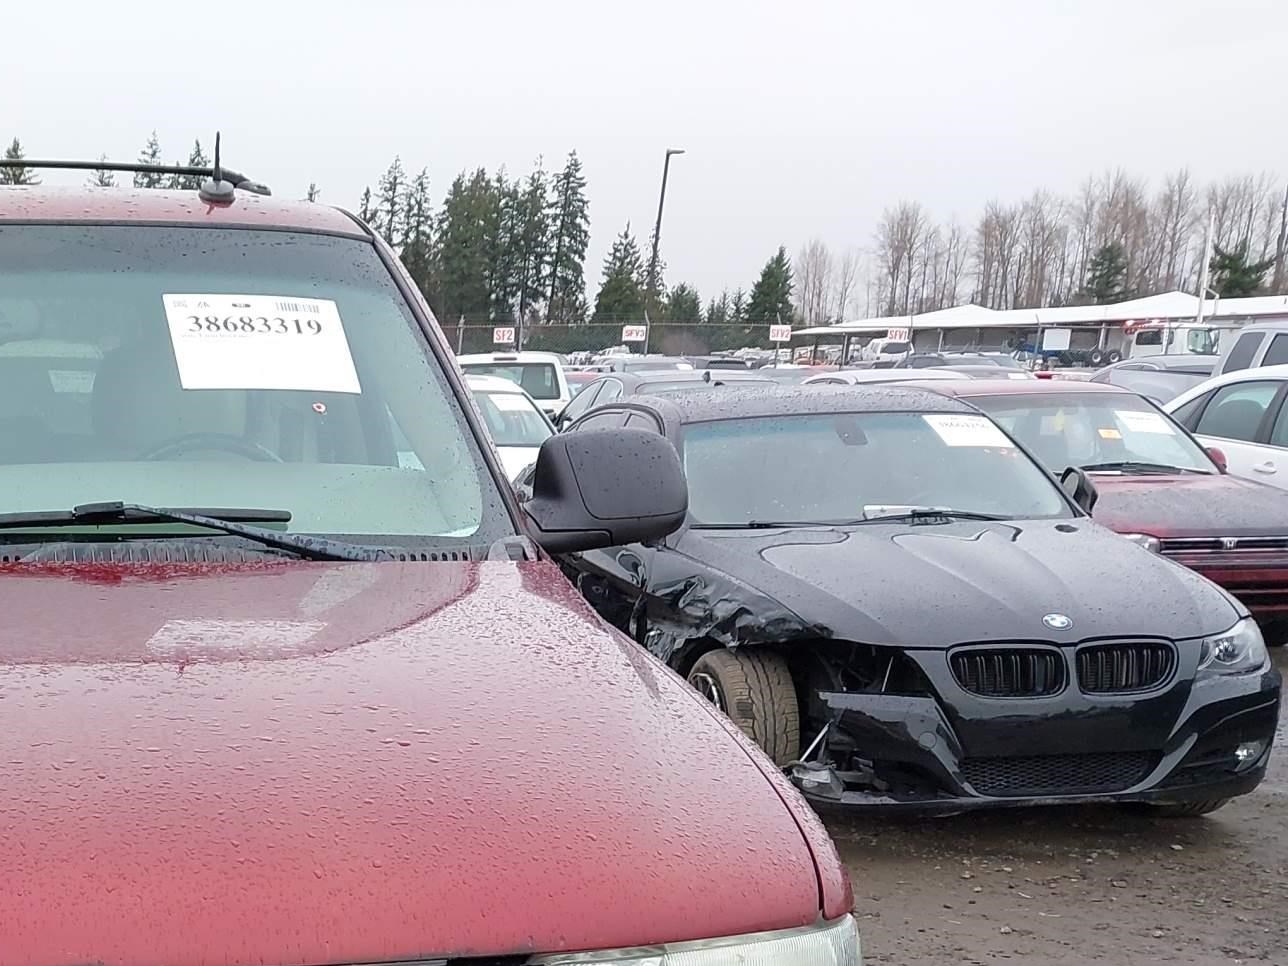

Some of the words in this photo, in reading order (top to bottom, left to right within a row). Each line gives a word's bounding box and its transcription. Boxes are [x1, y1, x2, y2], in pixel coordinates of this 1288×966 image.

[187, 315, 322, 335] 38683319
[495, 329, 513, 341] SF2
[625, 328, 645, 338] SFV3
[771, 328, 790, 339] SFV2
